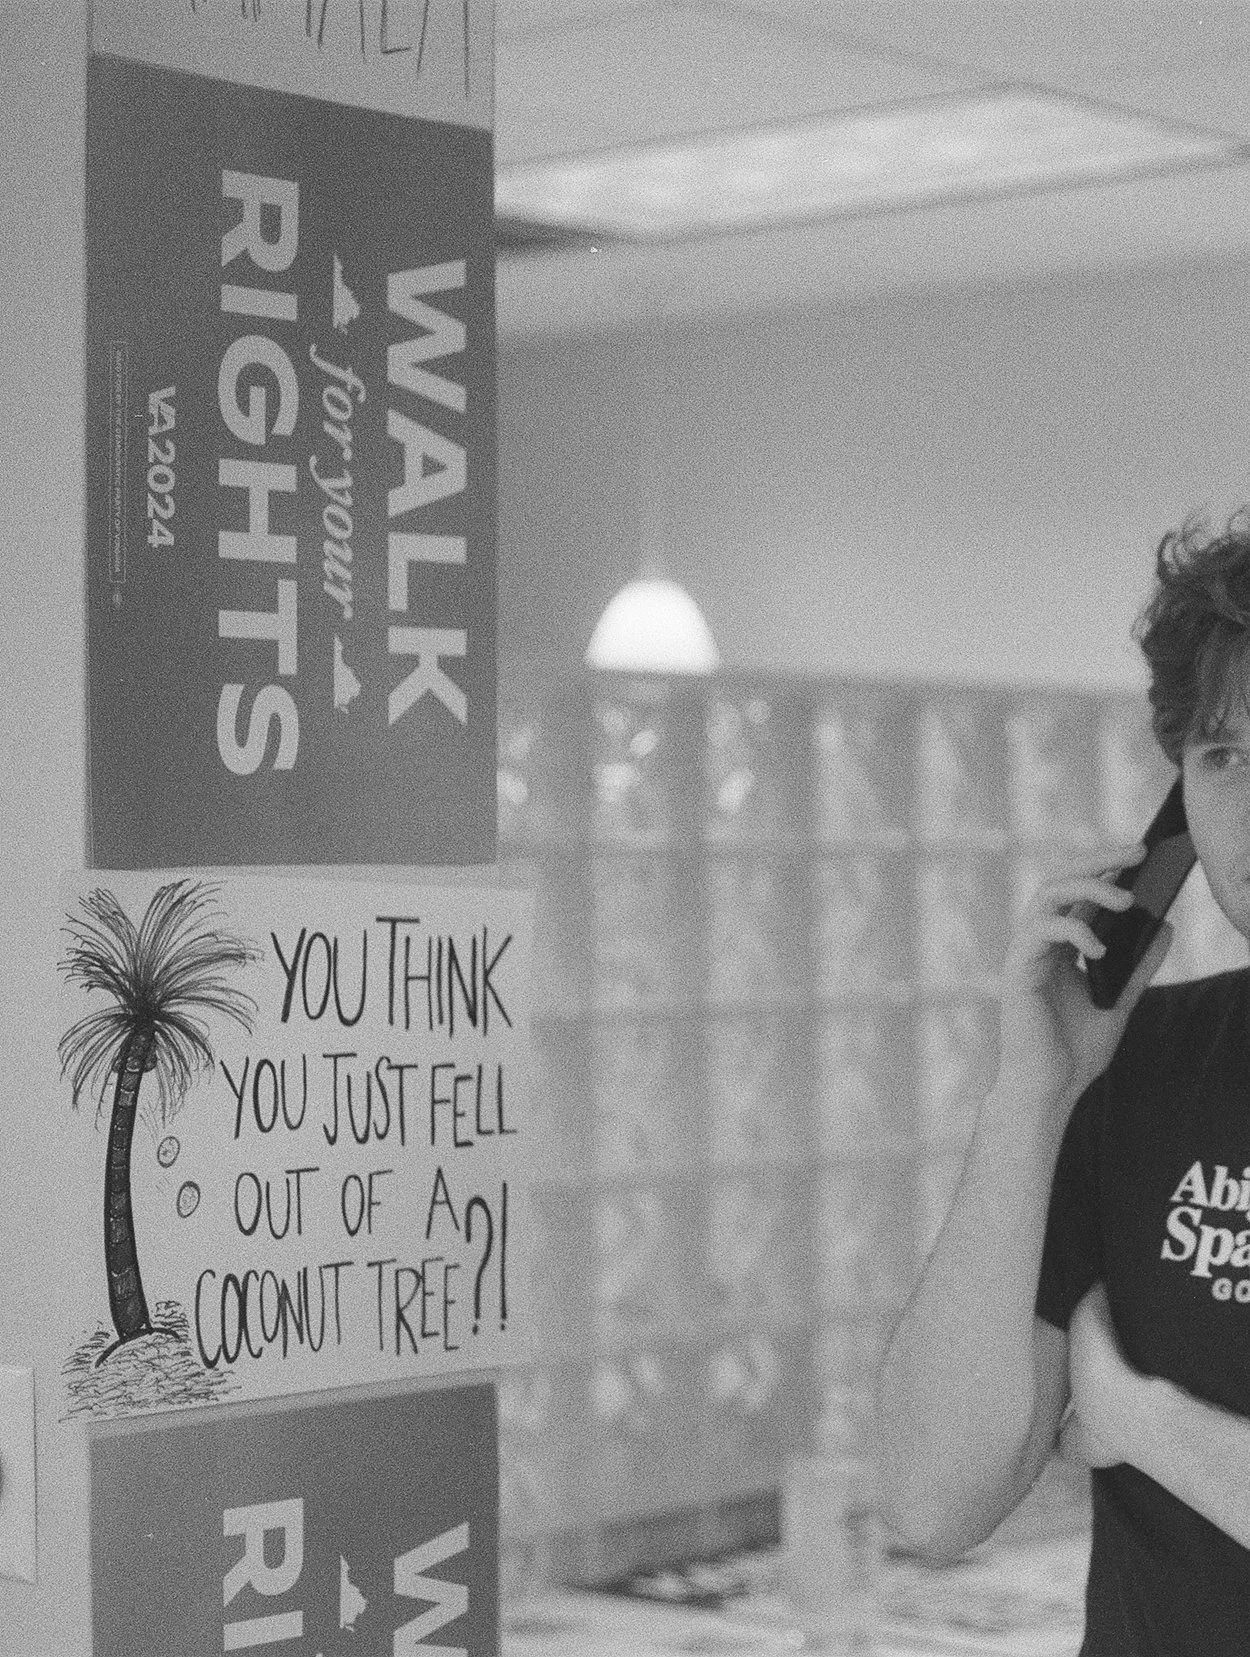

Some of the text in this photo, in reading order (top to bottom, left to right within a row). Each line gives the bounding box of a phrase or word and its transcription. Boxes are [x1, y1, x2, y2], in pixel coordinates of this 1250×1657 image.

[148, 386, 176, 548] VA2024
[217, 170, 299, 776] RIGHTS
[310, 344, 366, 619] for your
[388, 259, 467, 725] WALK
[271, 917, 513, 1038] YOU THINK
[220, 1052, 518, 1148] YOU JUST FELL
[234, 1166, 460, 1240] OUT OF A
[195, 1262, 354, 1369] COCONUT
